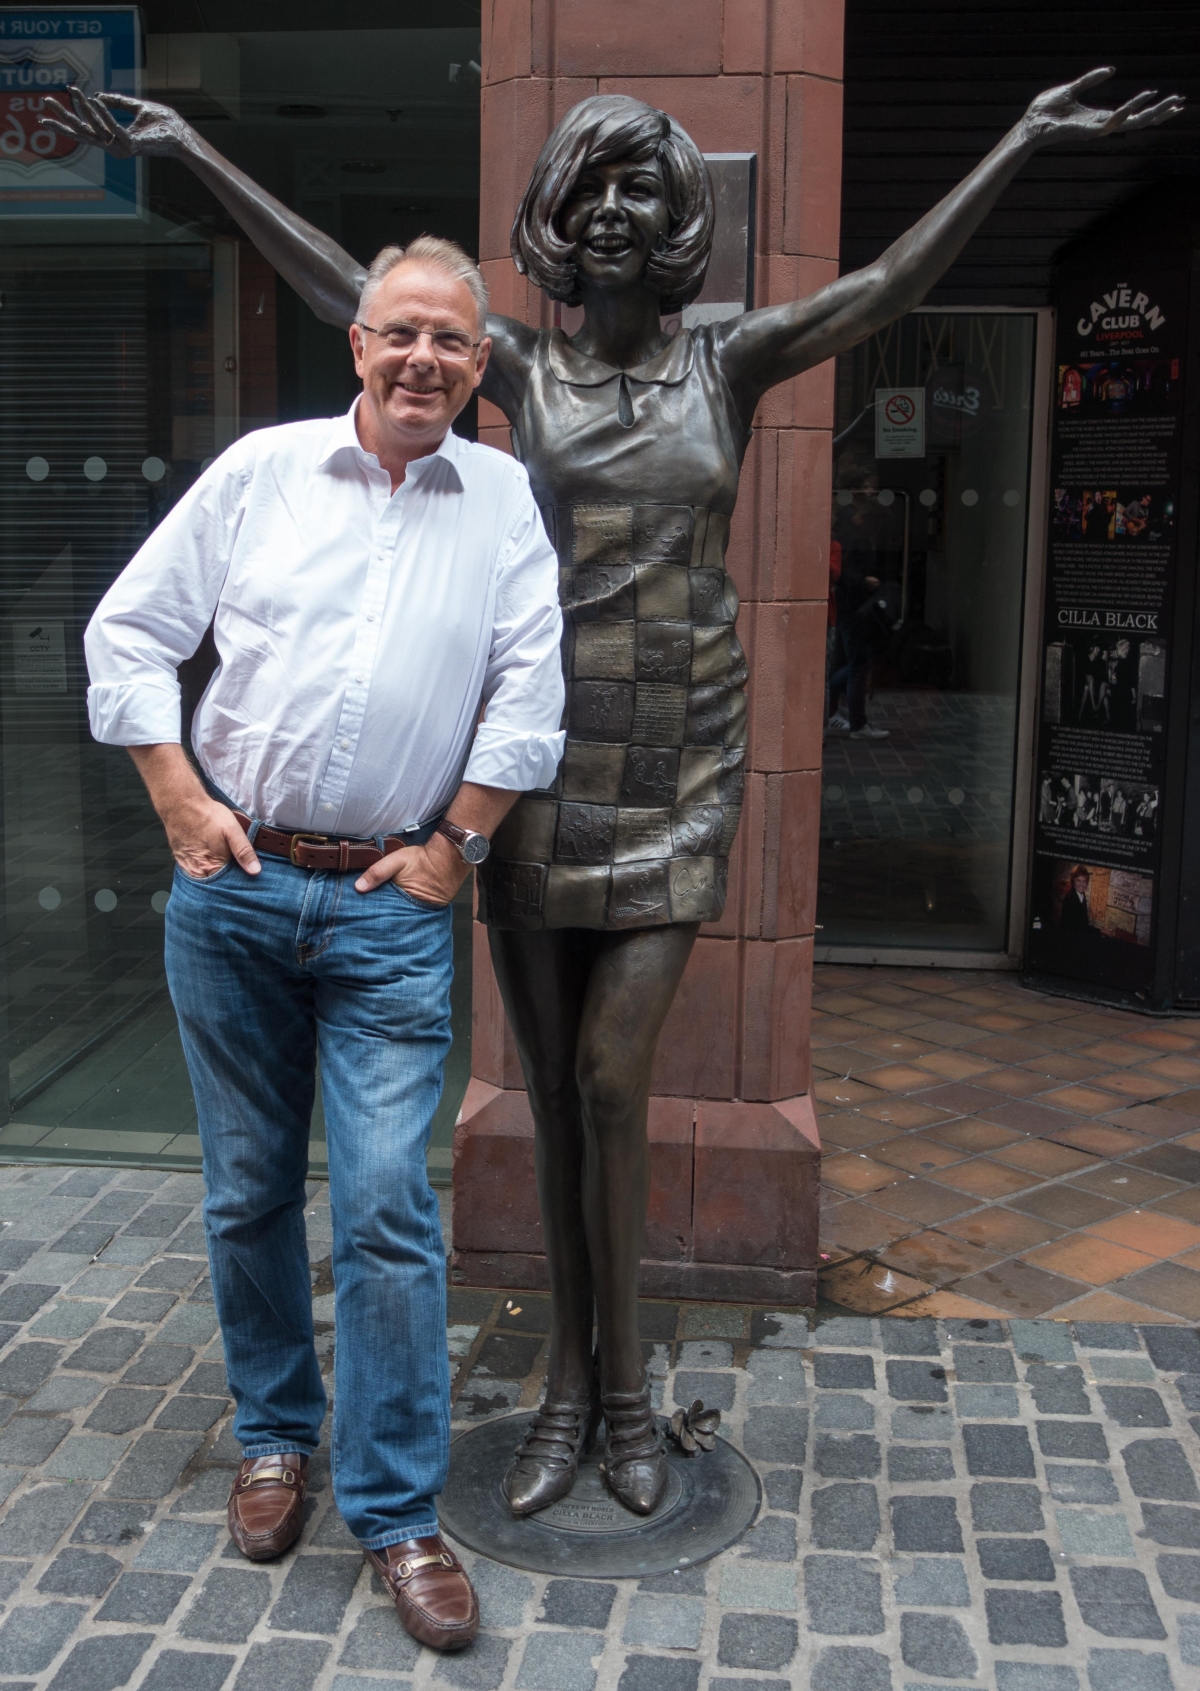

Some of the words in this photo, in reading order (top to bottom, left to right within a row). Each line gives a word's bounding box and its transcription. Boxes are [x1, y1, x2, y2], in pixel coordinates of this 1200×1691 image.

[1077, 289, 1166, 336] CAVERN
[1101, 315, 1140, 330] CLUB
[1096, 330, 1144, 341] LIVERPOOL
[1150, 345, 1160, 353] On
[1058, 610, 1101, 626] CILLA
[1105, 612, 1158, 629] BLACK
[552, 1509, 580, 1518] CILLA
[582, 1512, 614, 1521] BLACK
